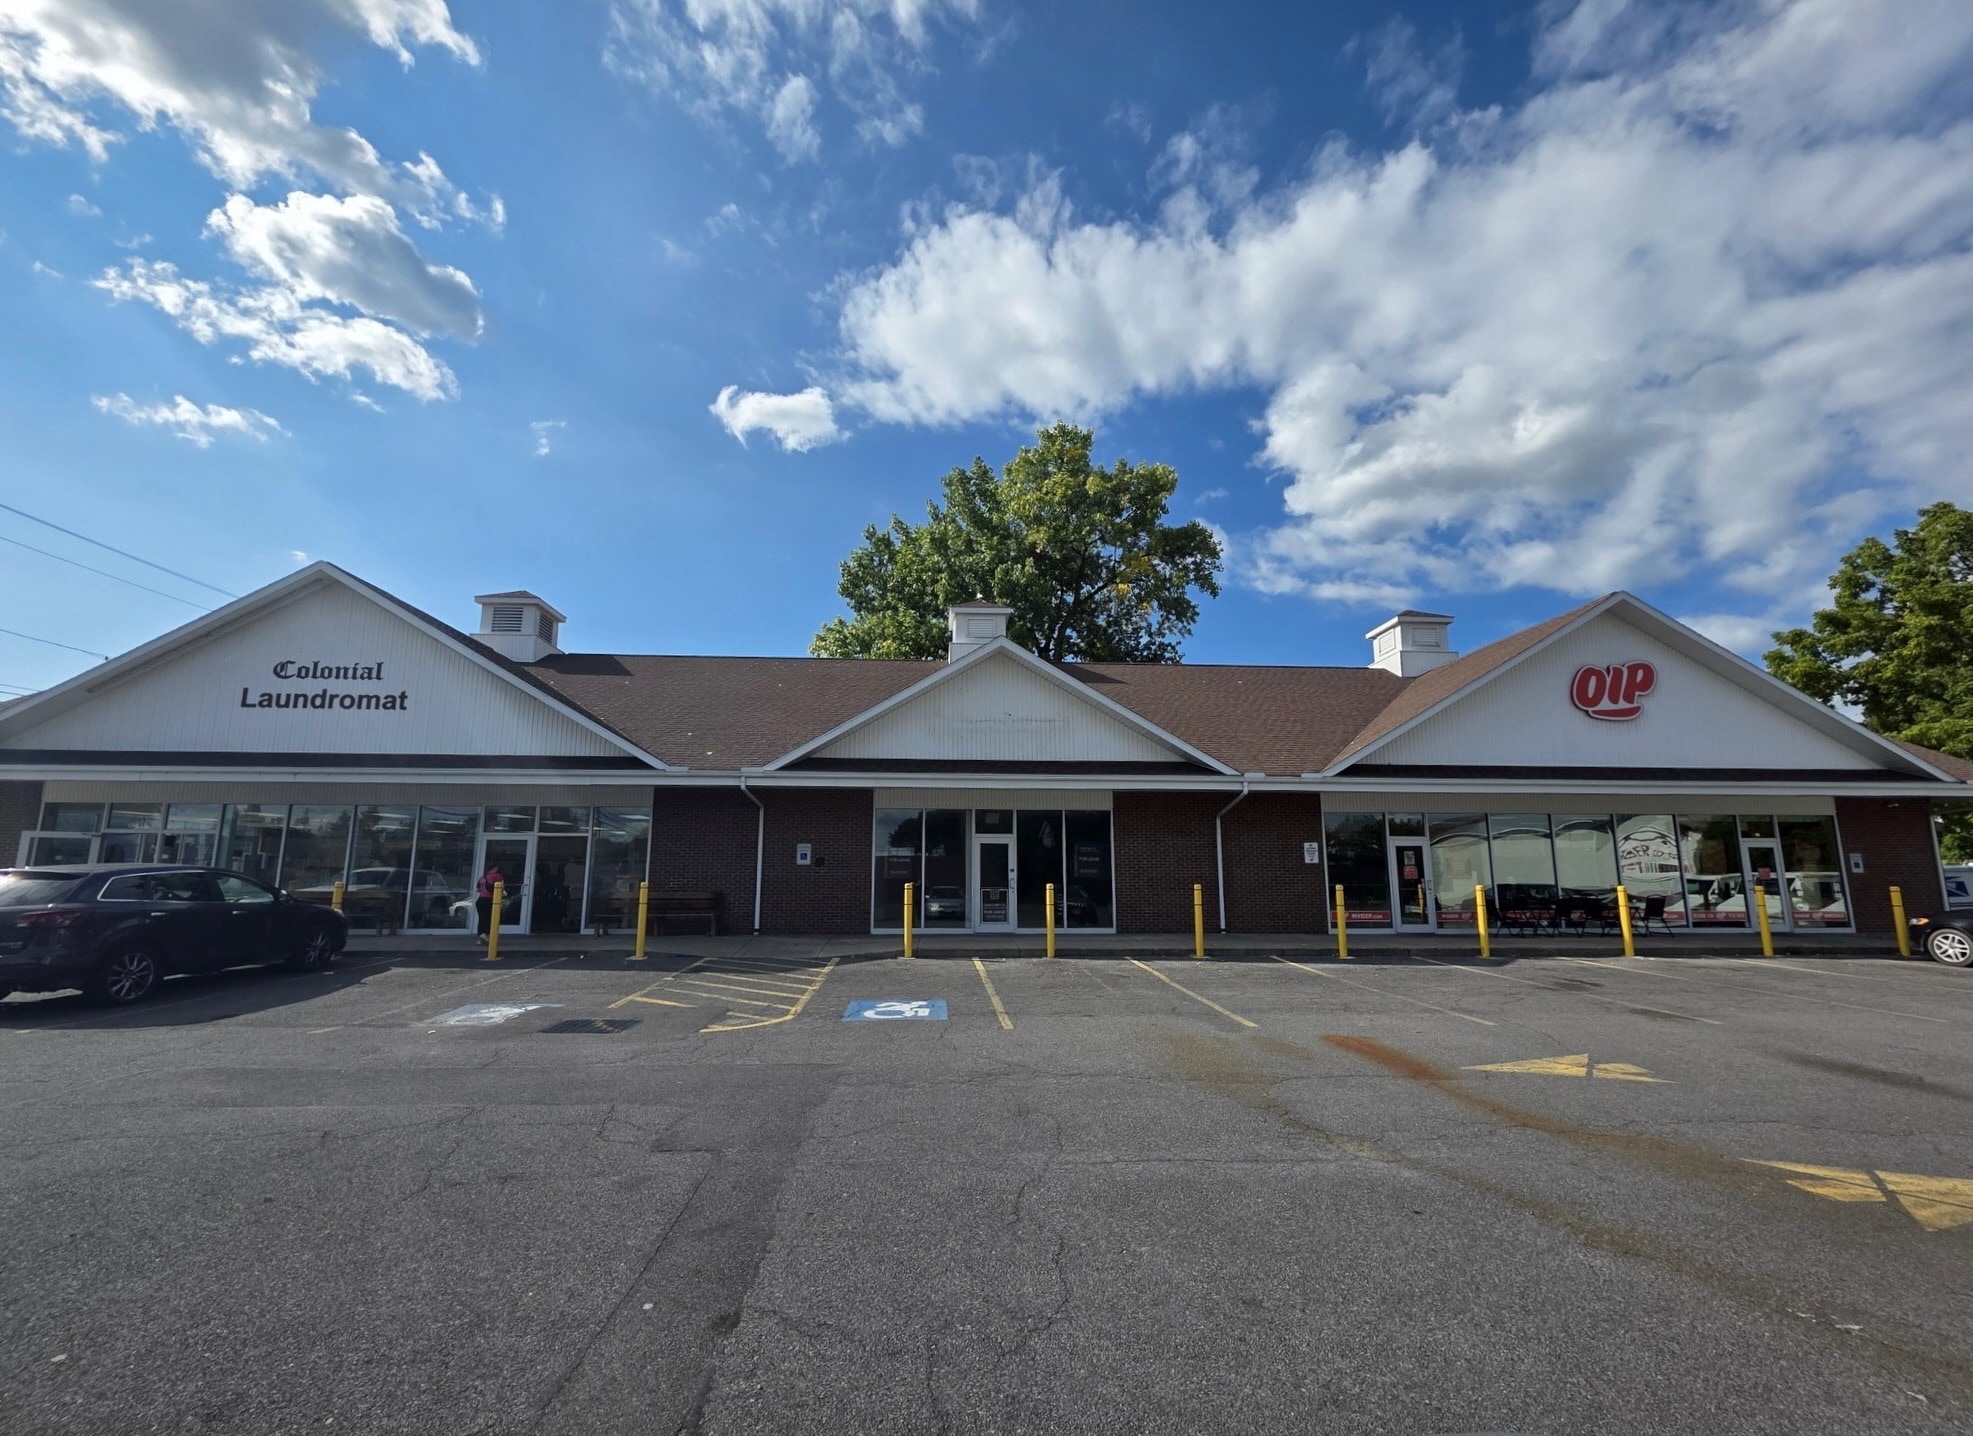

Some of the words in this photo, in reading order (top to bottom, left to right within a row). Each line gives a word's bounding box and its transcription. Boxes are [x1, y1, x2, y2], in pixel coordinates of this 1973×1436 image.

[273, 660, 384, 681] Colonial
[1572, 661, 1657, 712] OIP
[240, 687, 408, 710] Laundromat
